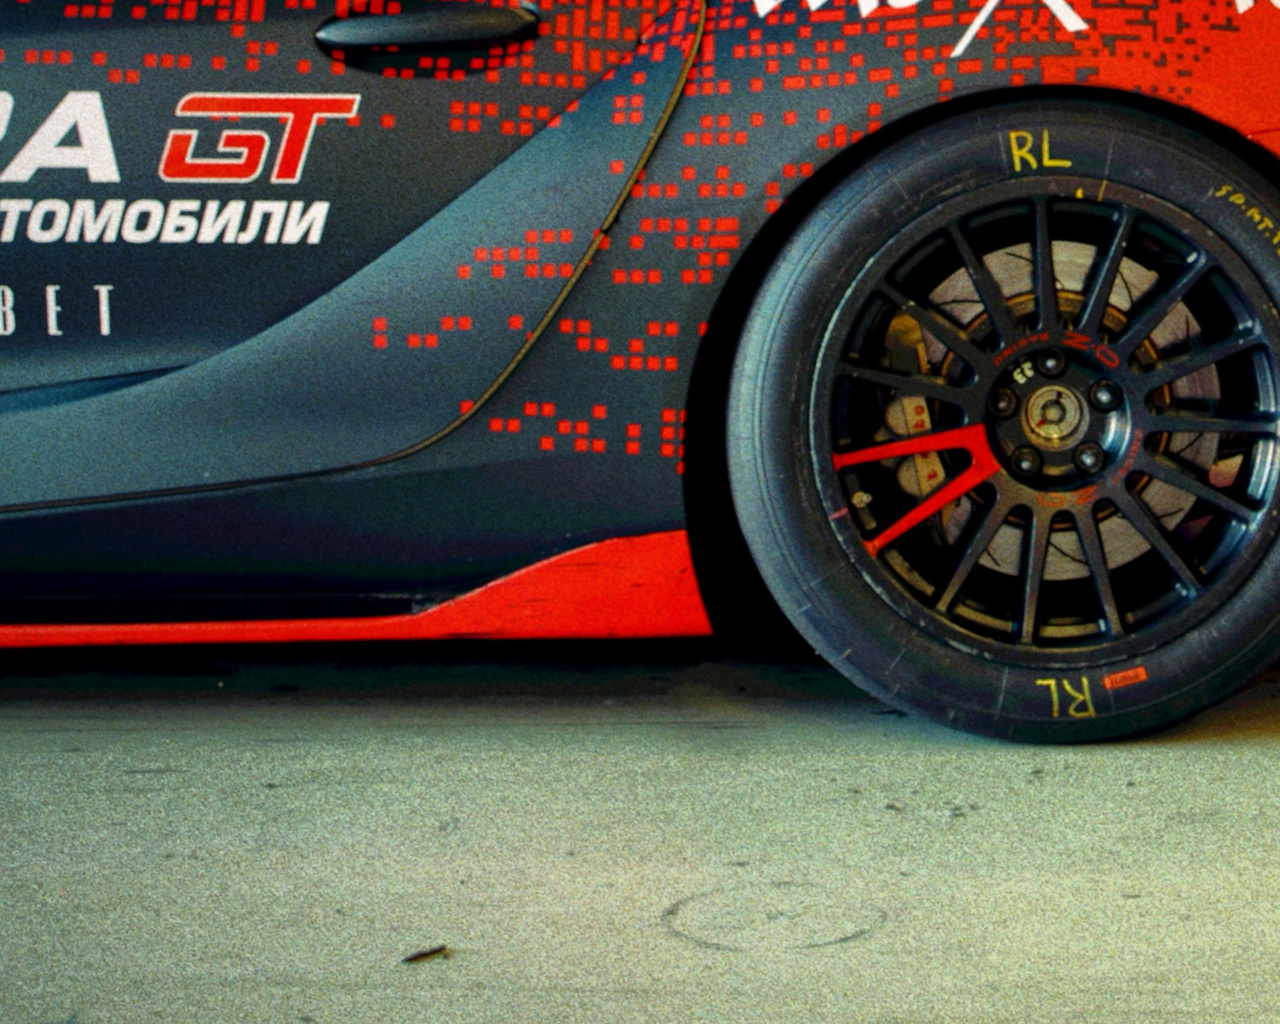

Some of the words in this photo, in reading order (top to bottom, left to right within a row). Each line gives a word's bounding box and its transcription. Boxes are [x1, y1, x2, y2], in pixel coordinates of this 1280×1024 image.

[158, 93, 362, 184] GT
[1008, 128, 1073, 173] RL
[1035, 675, 1096, 718] RL
